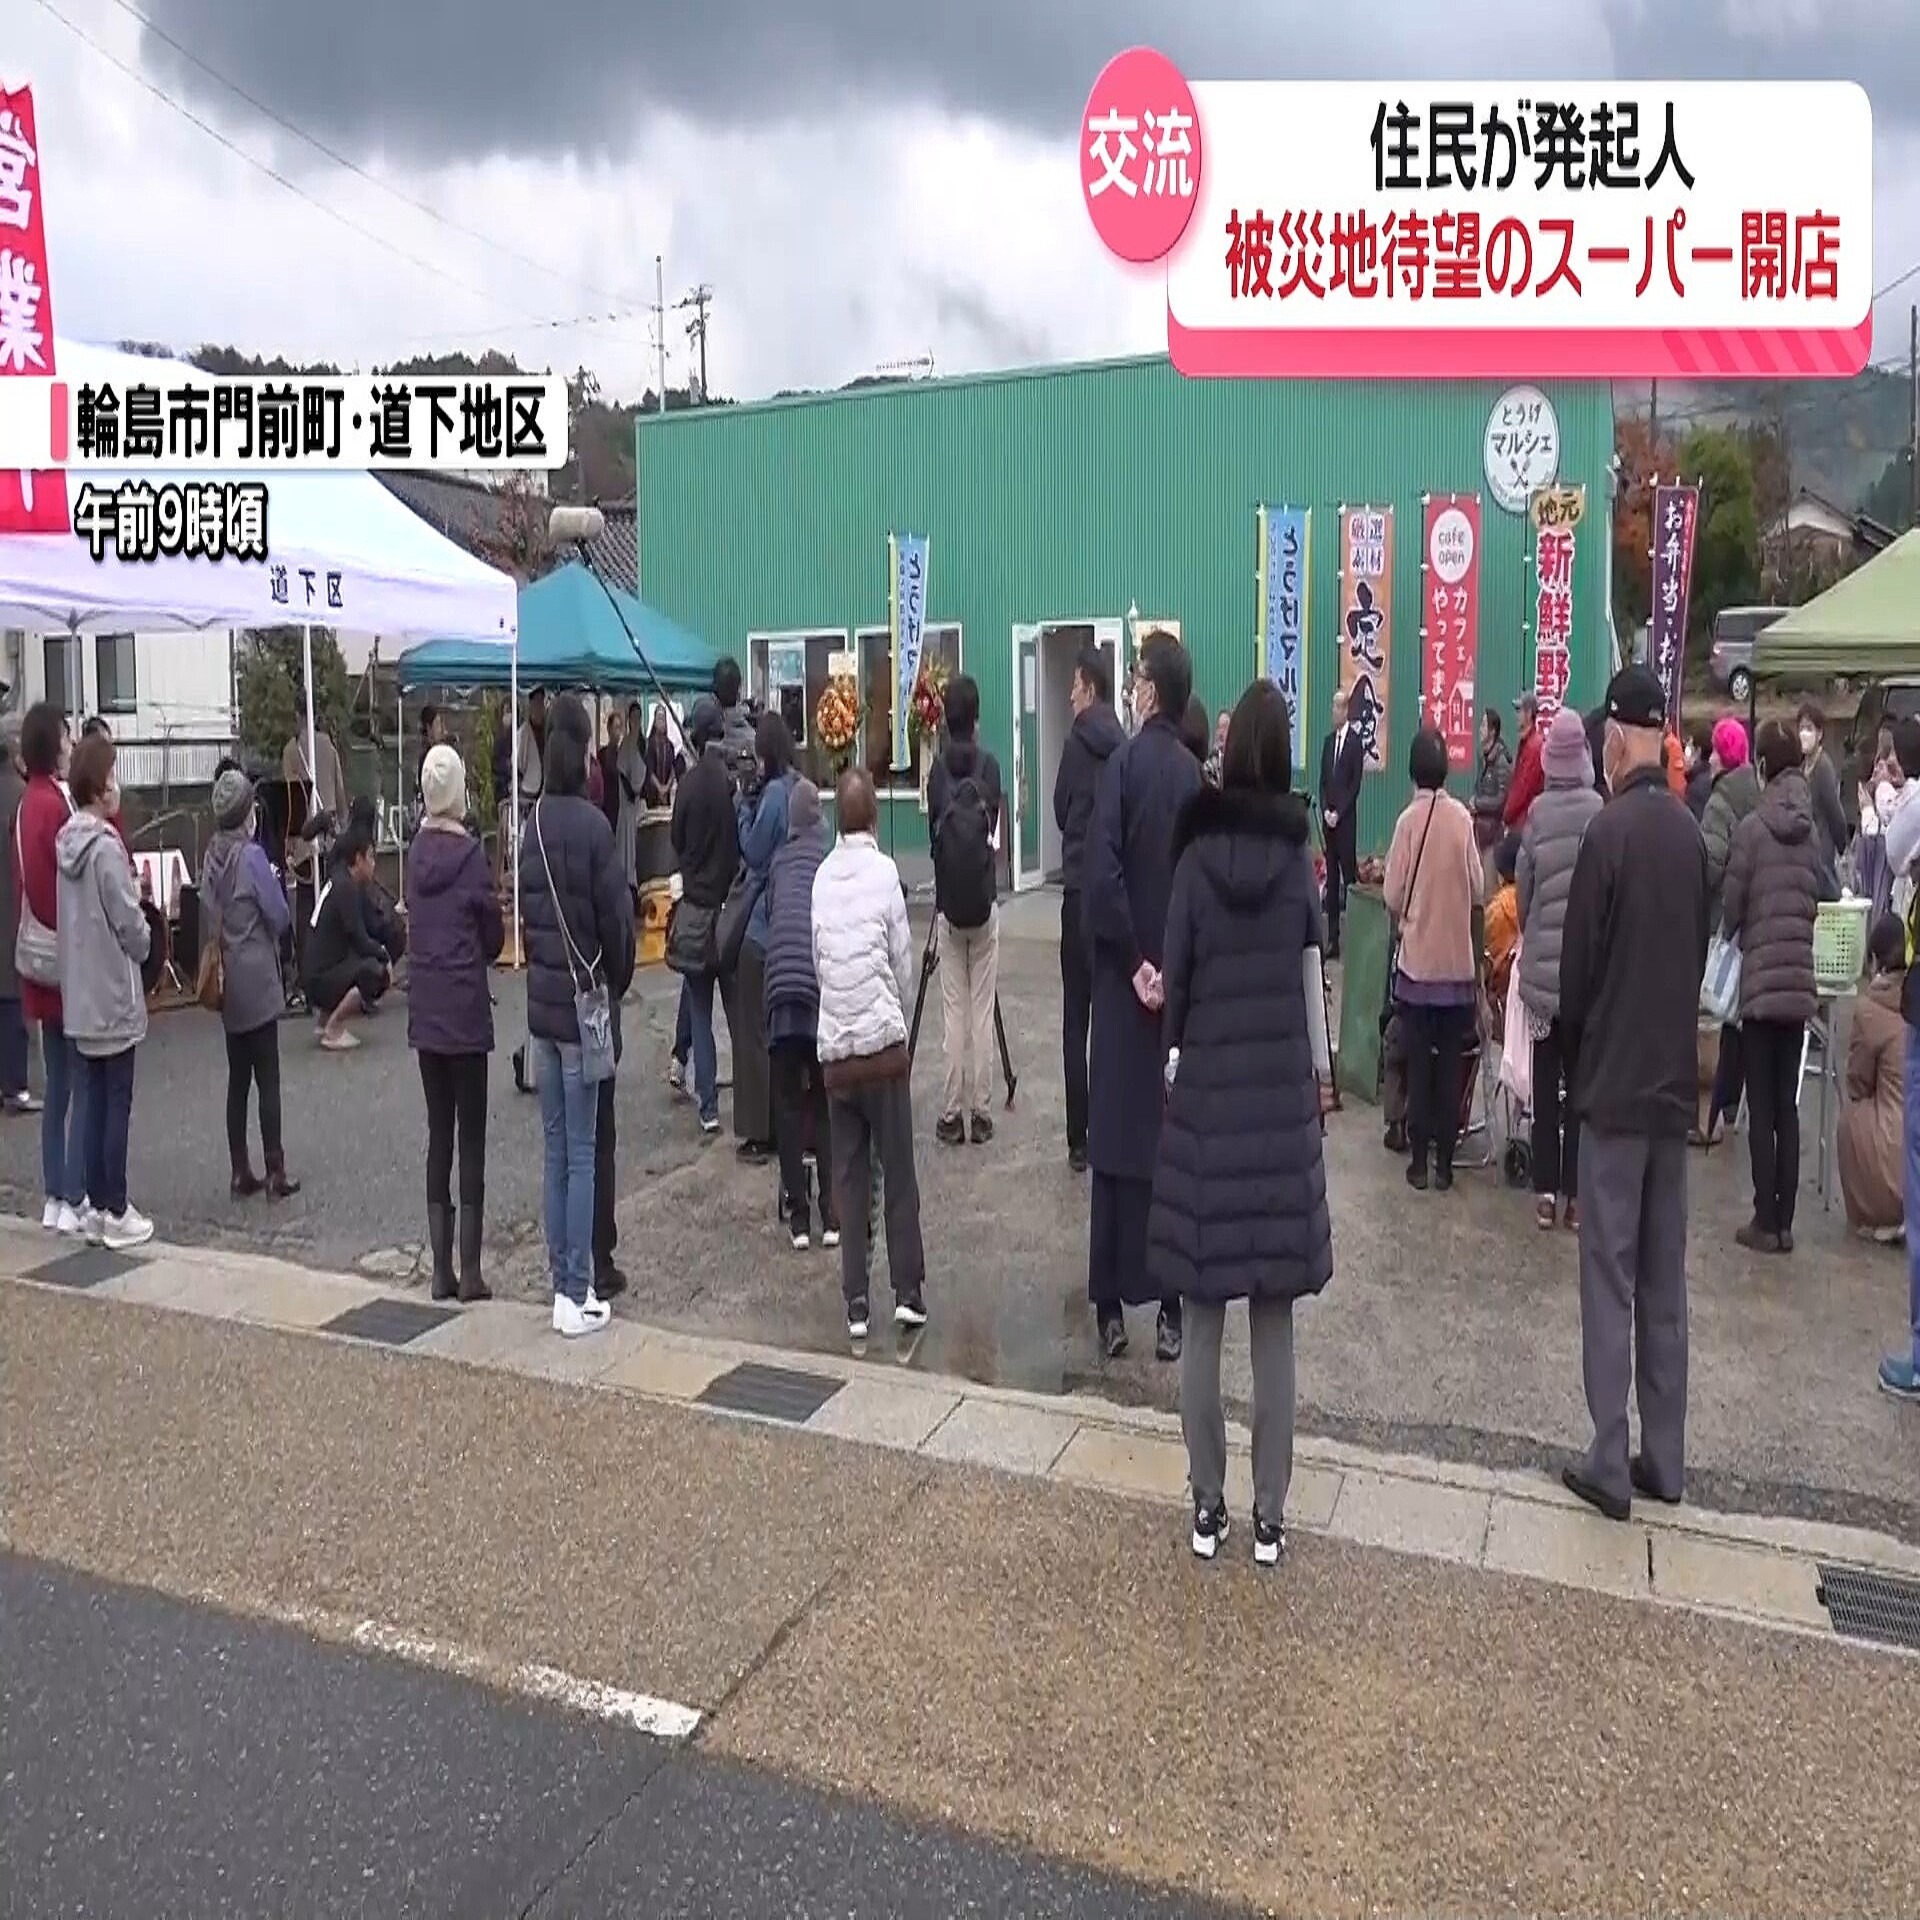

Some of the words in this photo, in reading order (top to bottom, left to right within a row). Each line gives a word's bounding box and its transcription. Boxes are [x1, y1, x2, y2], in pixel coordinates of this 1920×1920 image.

[1490, 430, 1553, 456] マルシェ
[1537, 492, 1580, 525] 地元
[270, 564, 344, 608] 道下区
[1453, 586, 1468, 662] カフェ
